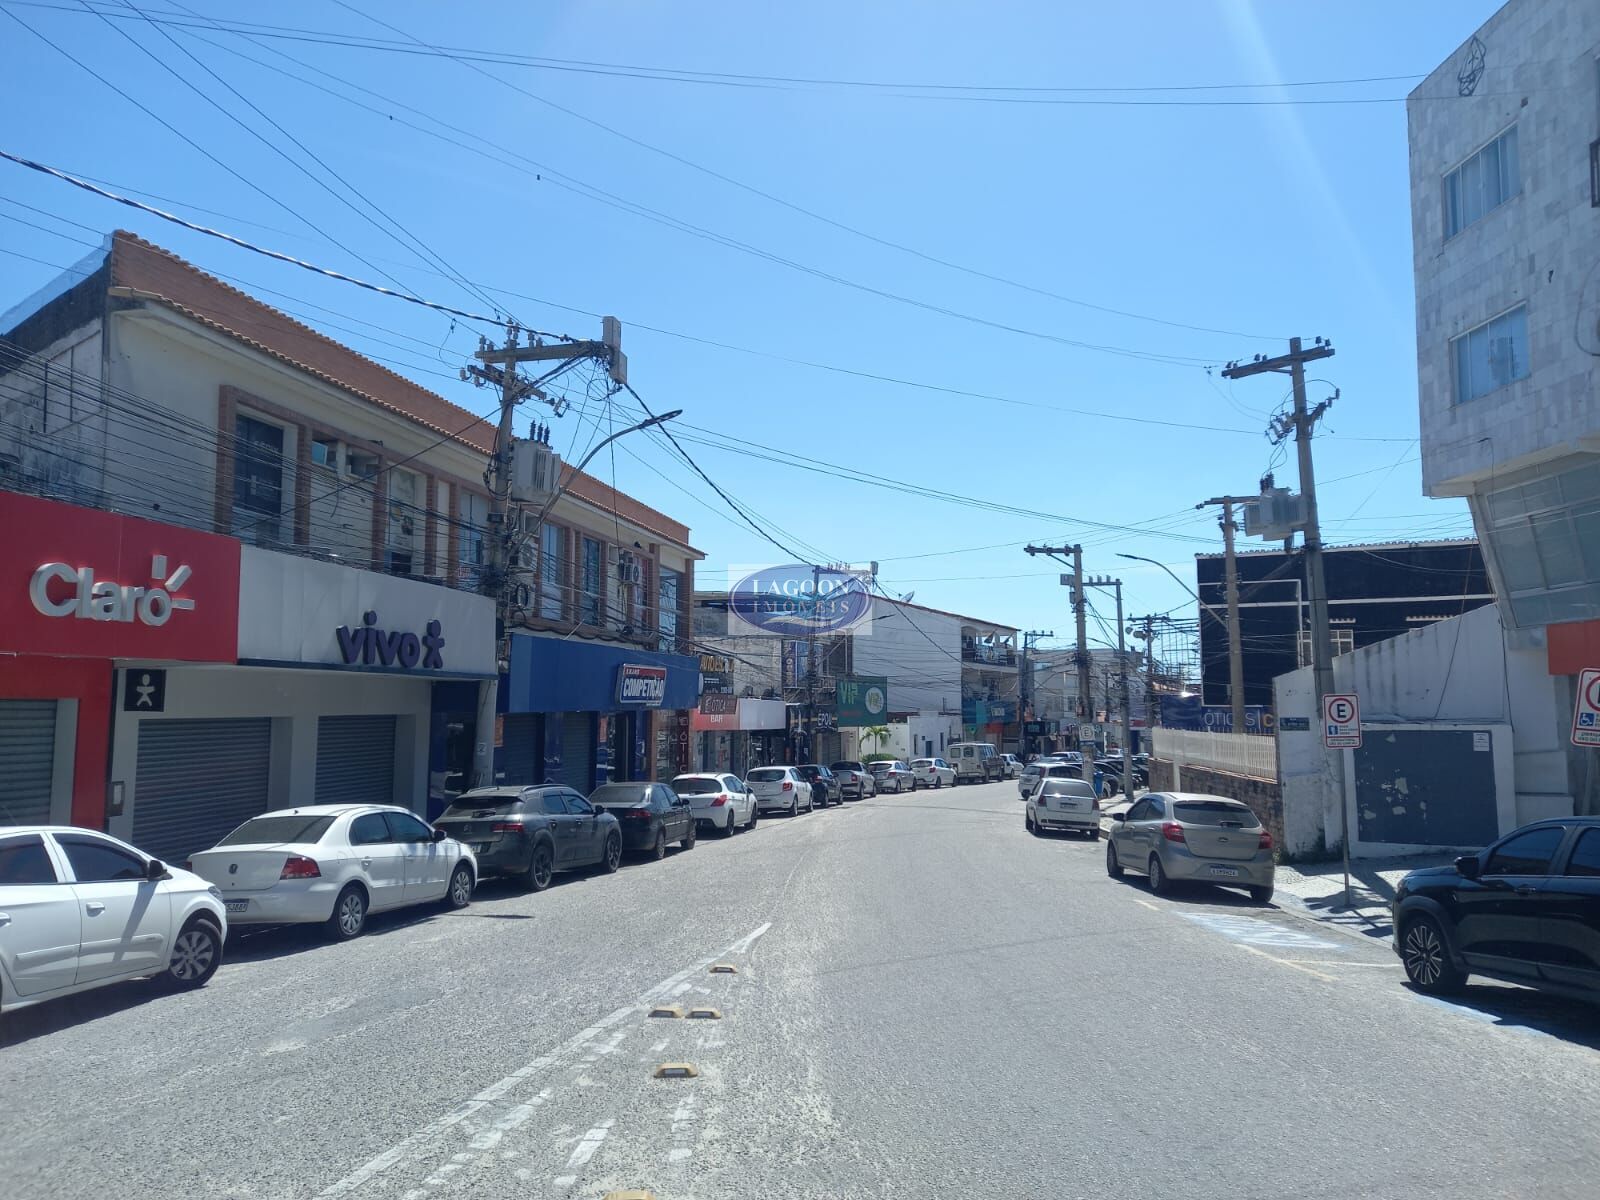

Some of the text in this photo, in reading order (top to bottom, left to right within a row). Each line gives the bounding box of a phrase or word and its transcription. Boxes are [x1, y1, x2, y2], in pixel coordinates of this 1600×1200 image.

[29, 562, 172, 627] Claro
[335, 609, 421, 669] vivo
[710, 714, 723, 723] BAR
[1204, 709, 1256, 727] ÓTICS
[1337, 703, 1347, 719] E
[1083, 729, 1090, 737] E
